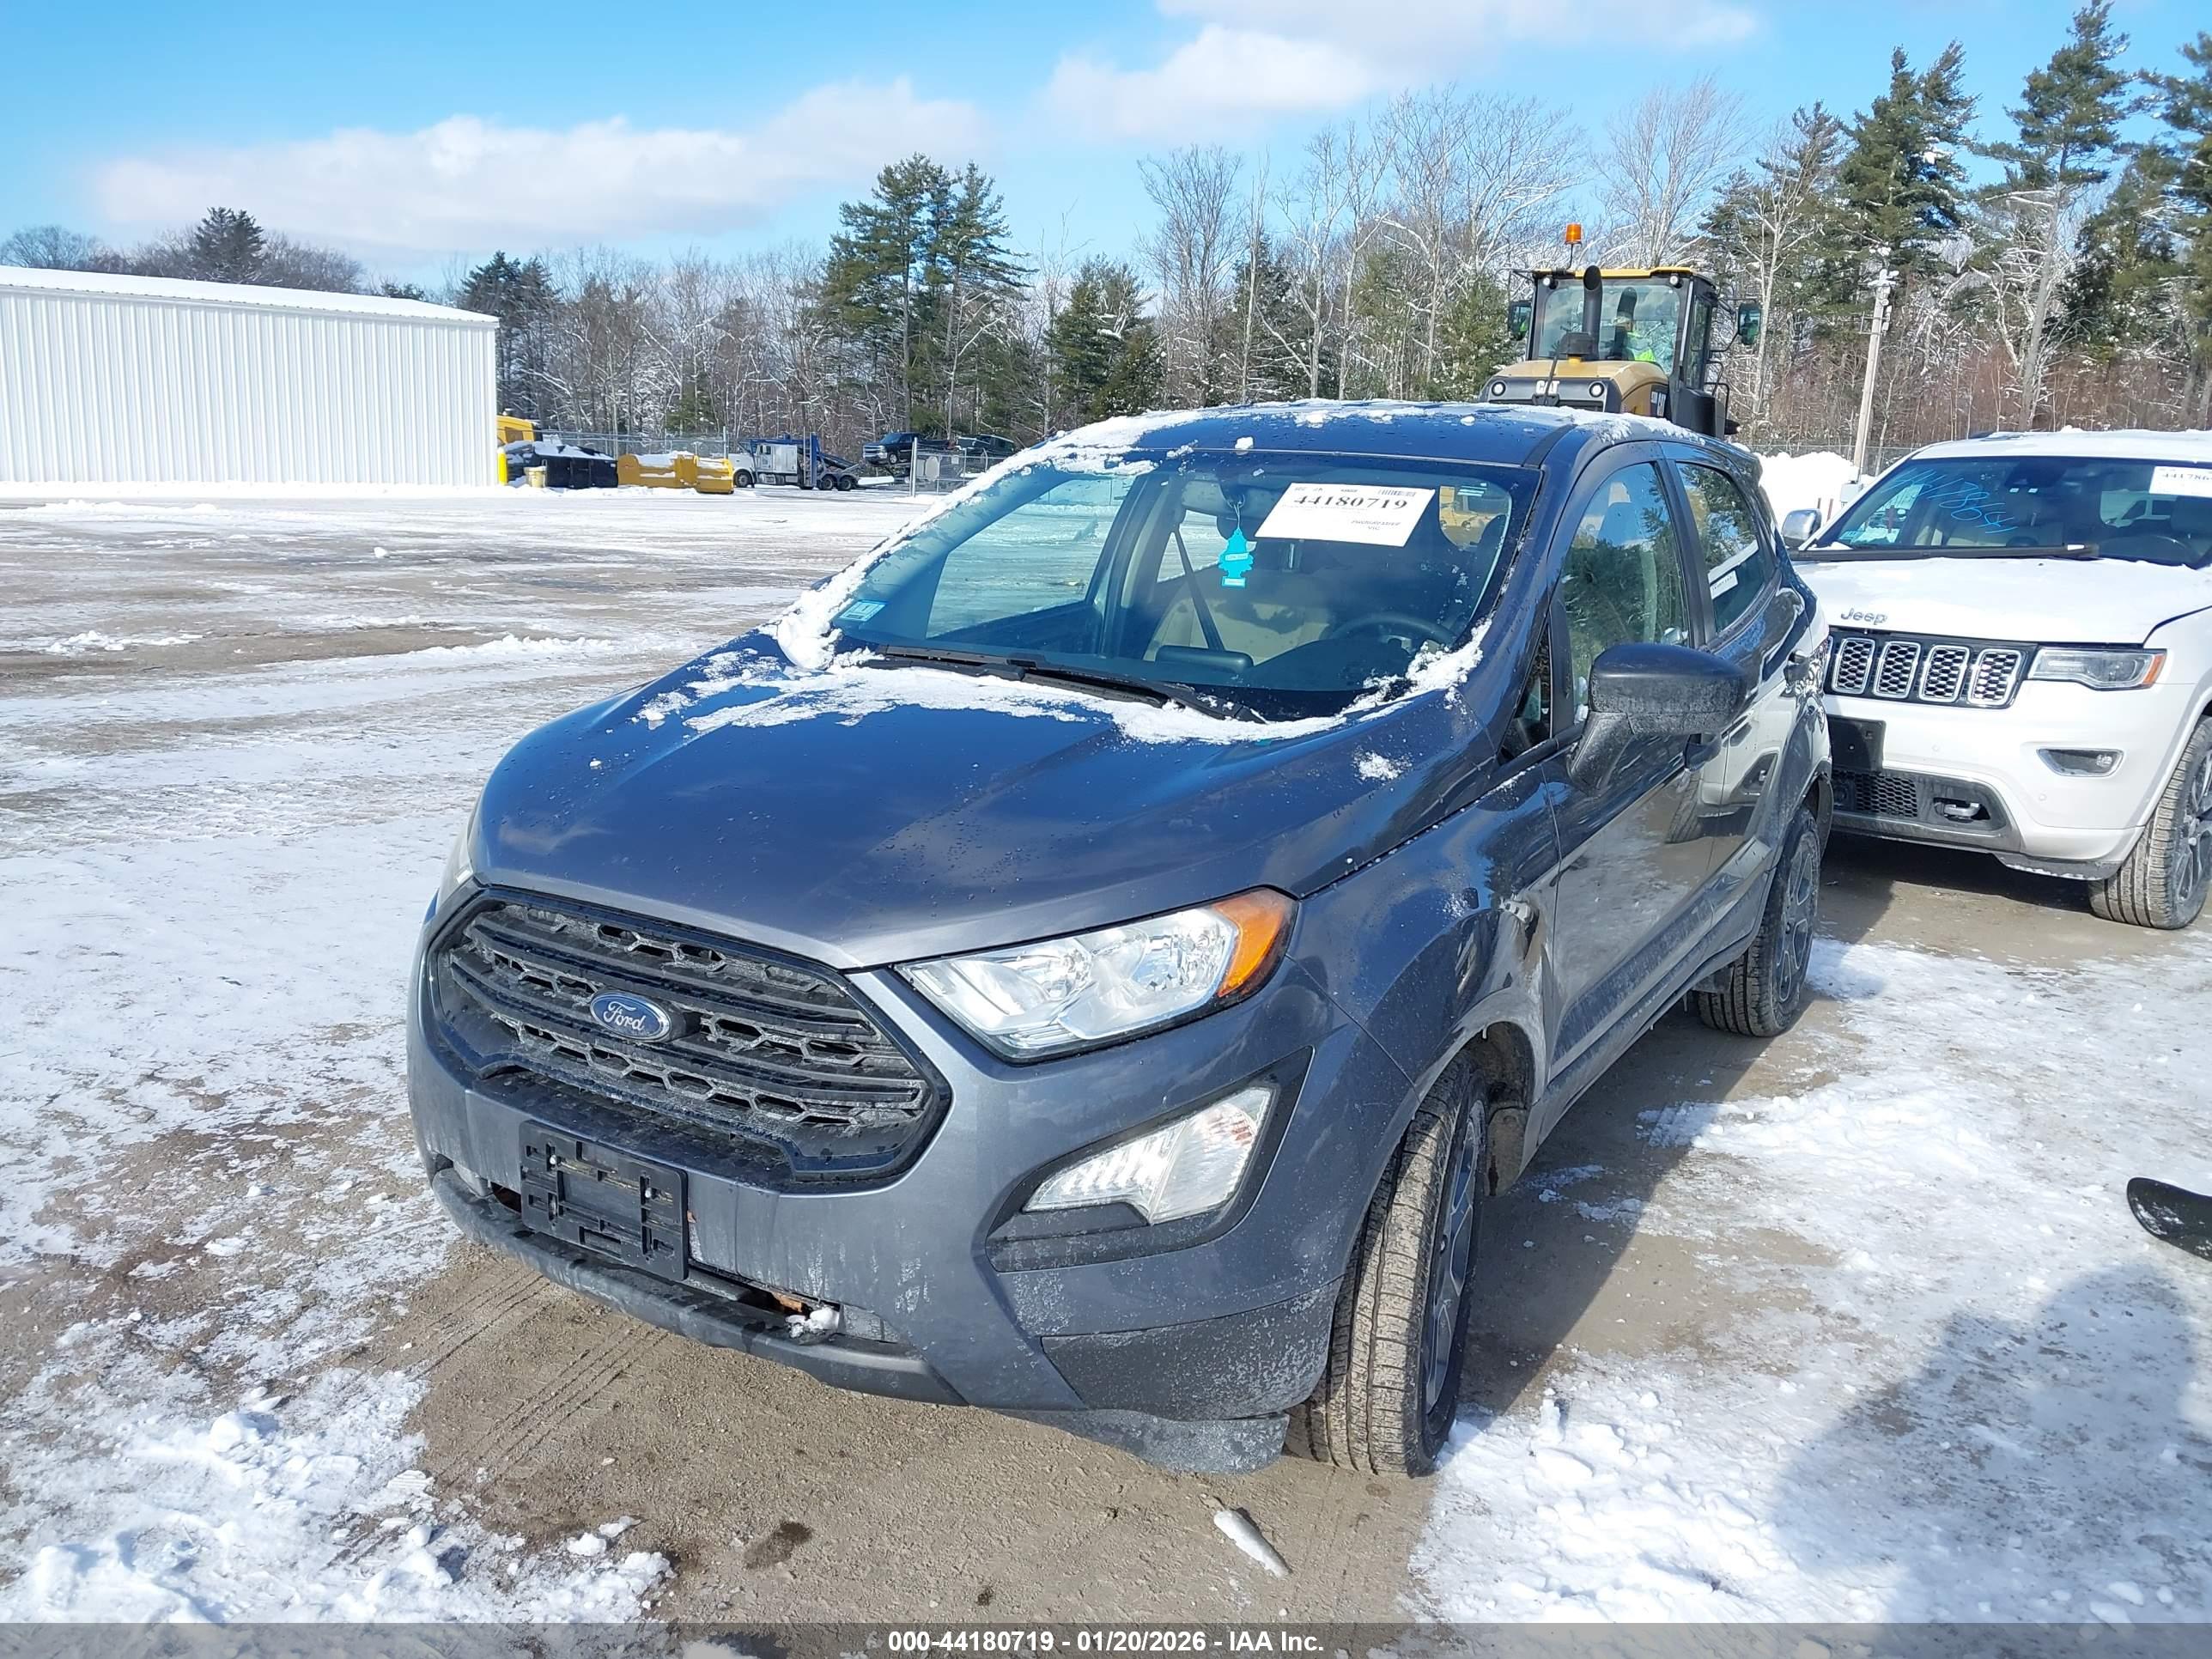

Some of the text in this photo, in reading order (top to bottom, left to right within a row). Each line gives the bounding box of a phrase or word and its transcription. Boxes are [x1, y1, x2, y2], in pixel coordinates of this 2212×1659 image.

[1535, 380, 1559, 395] CAT
[1293, 495, 1408, 510] 44180719
[1840, 607, 1888, 626] Jeep
[603, 1000, 647, 1031] Ford
